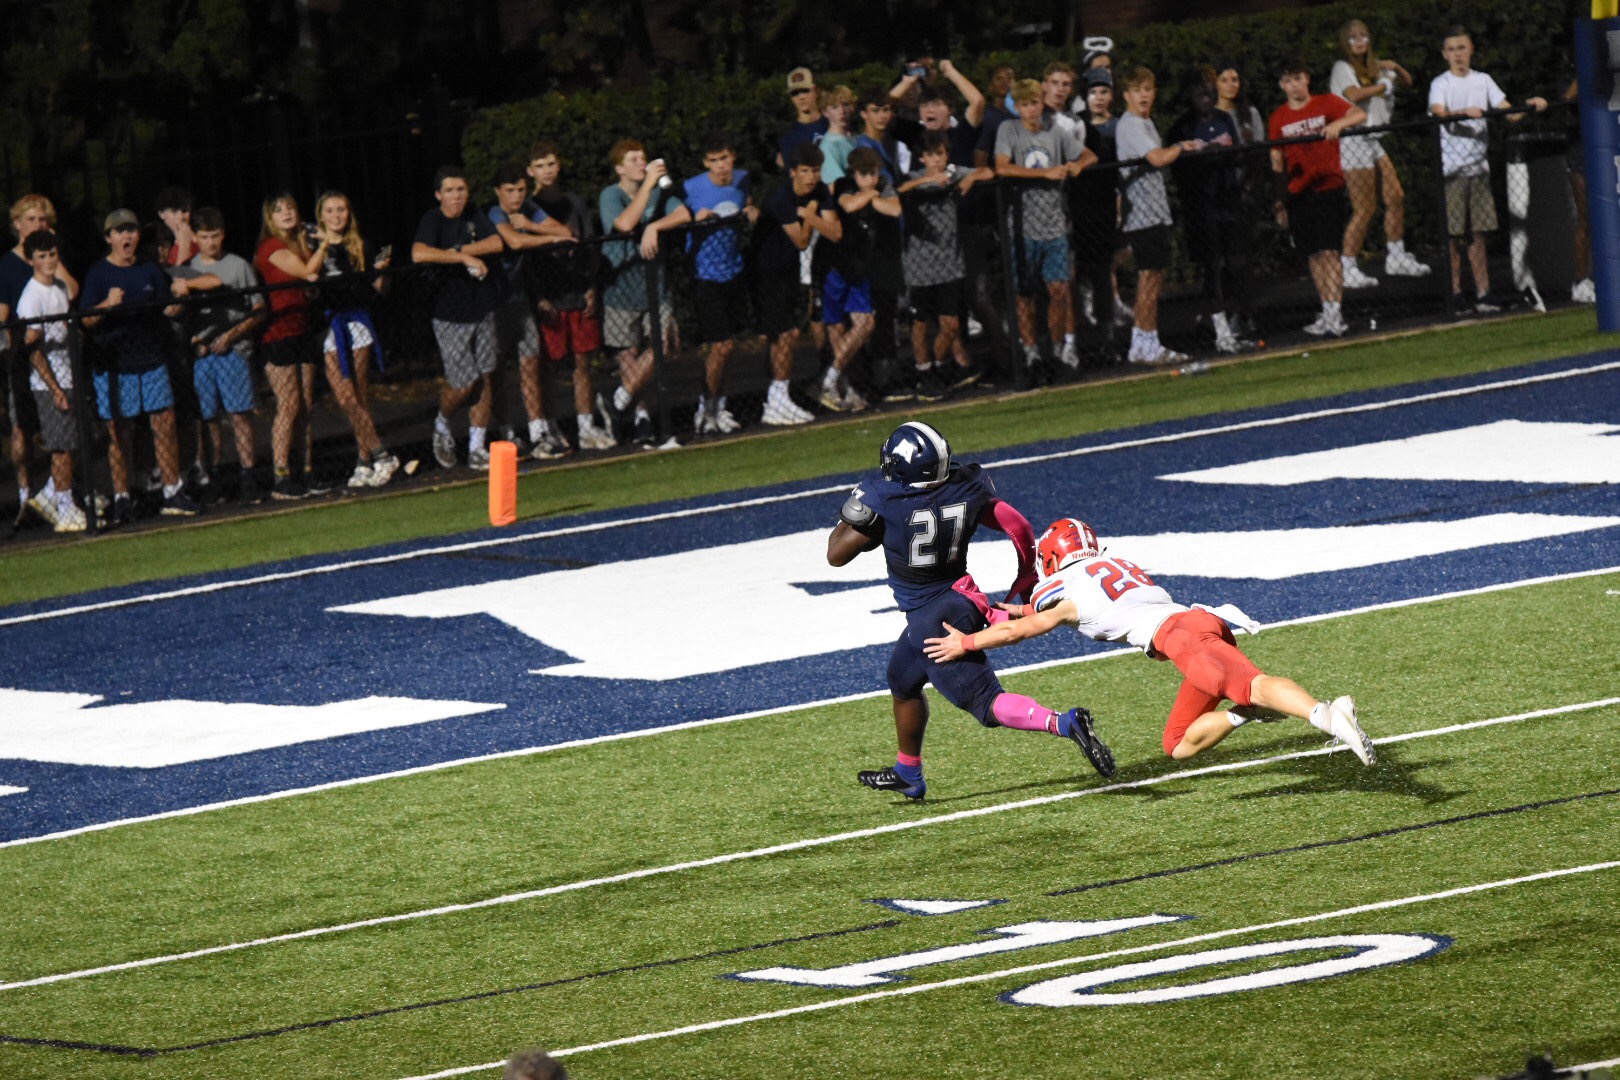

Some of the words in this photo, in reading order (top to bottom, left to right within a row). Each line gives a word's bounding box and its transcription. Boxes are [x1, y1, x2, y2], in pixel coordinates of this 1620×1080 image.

[908, 501, 967, 568] 27
[1085, 557, 1156, 602] 28
[724, 911, 1447, 1006] 10
